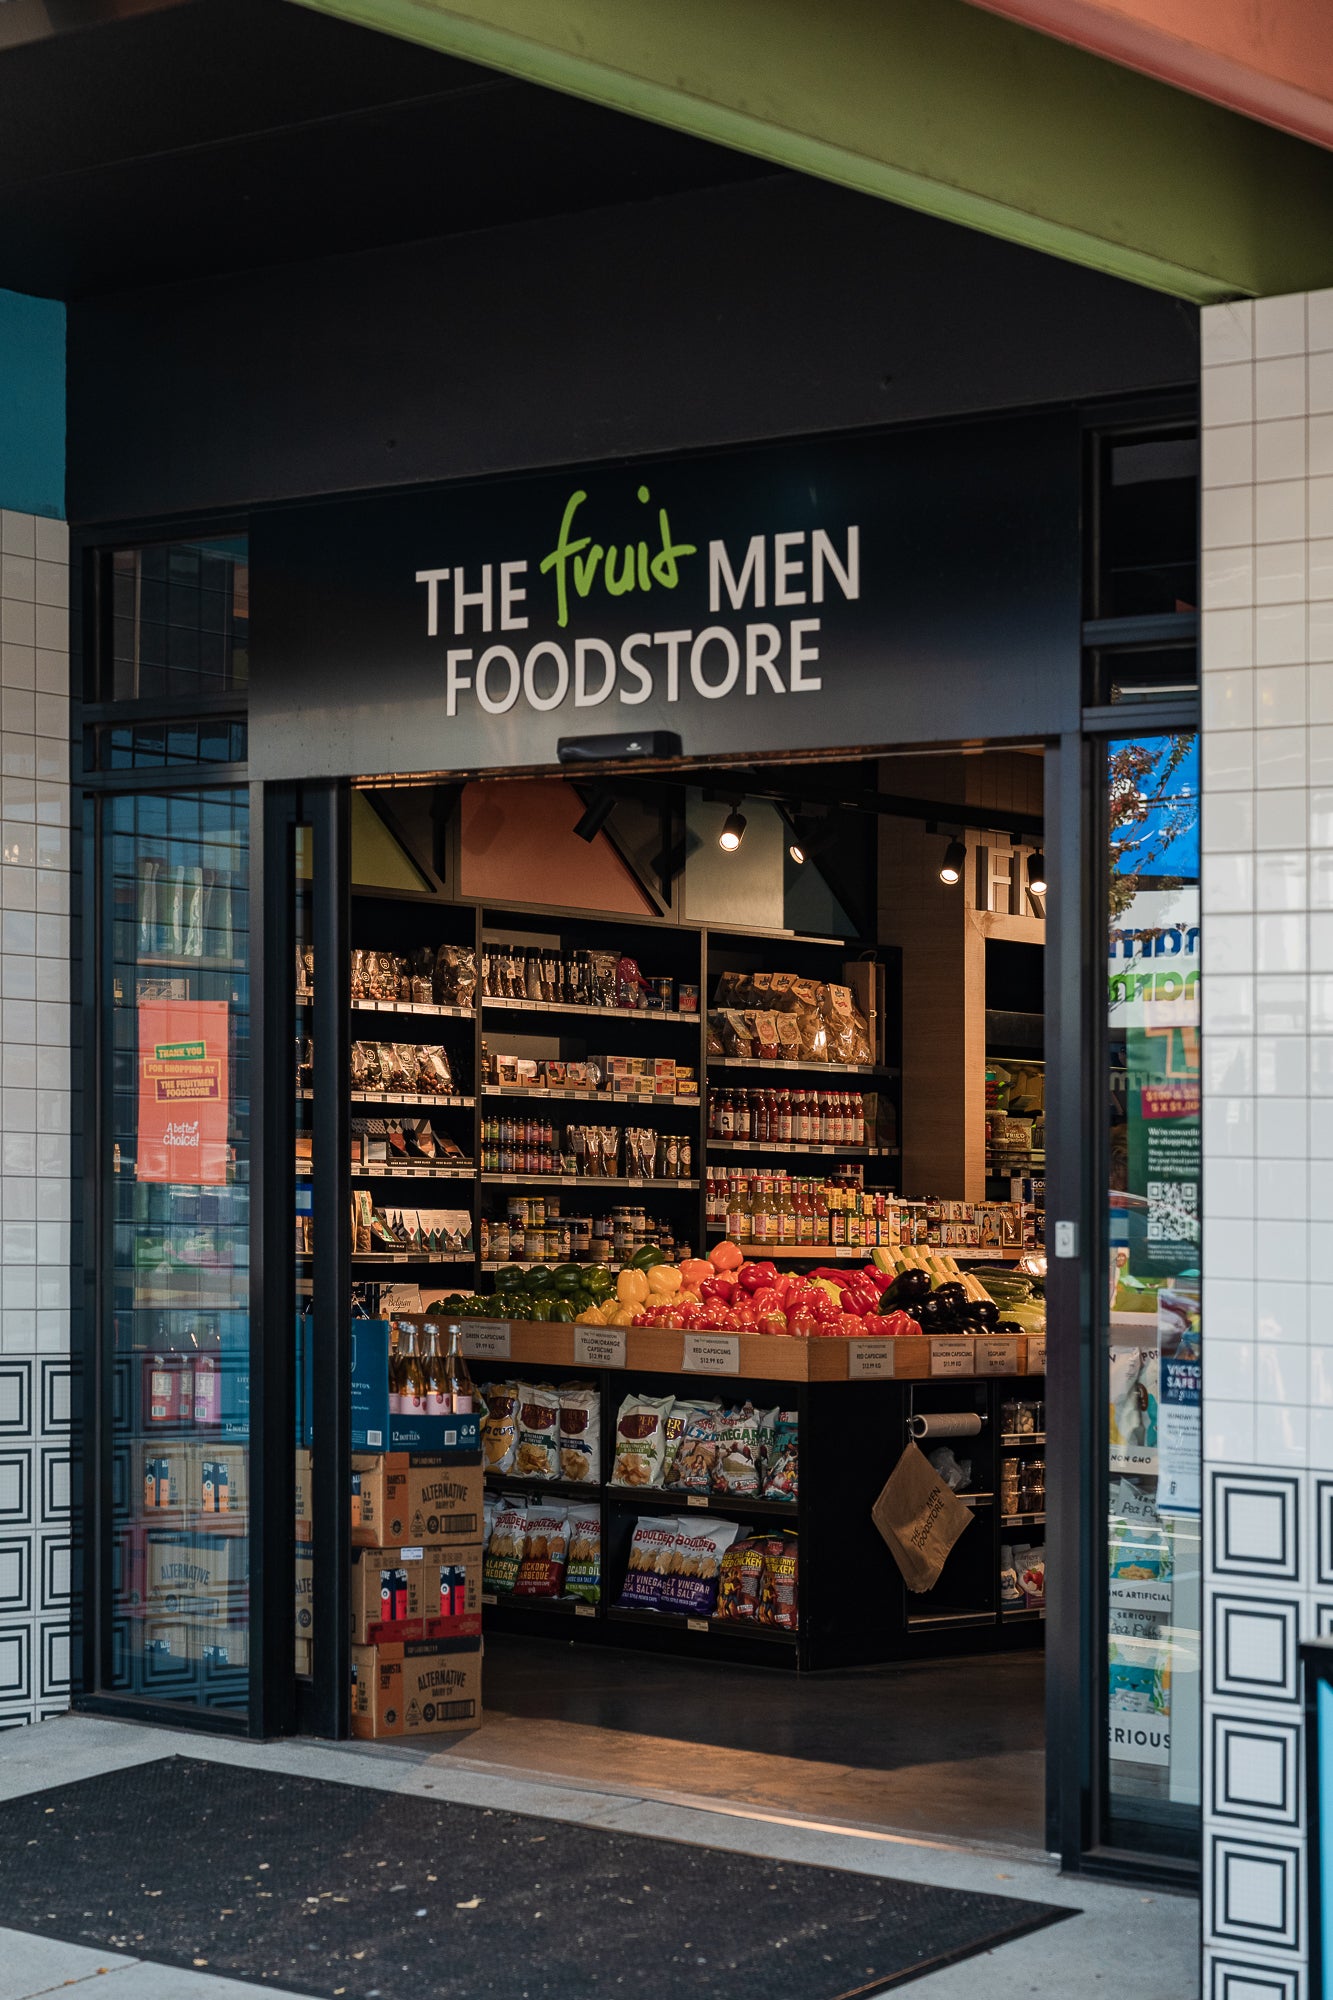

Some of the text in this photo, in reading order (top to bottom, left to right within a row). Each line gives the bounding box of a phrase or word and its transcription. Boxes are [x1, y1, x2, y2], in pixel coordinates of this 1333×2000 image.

[415, 485, 860, 636] THE fruit MEN
[446, 618, 823, 717] FOODSTORE
[158, 1046, 203, 1059] THANK YOU
[149, 1064, 215, 1074] FOR SHOPPING AT
[160, 1078, 214, 1089] THE FRUITMEN
[166, 1087, 210, 1098] FOODSTORE
[167, 1122, 196, 1133] A better
[163, 1132, 199, 1147] choice!
[480, 1333, 505, 1341] CAPSICUMS
[581, 1338, 620, 1347] YELLOW/ORANGE
[587, 1346, 613, 1354] CAPSICUMS
[692, 1347, 731, 1356] RED CAPSICUMS
[716, 1357, 724, 1365] KG
[392, 1431, 399, 1441] 12
[1110, 1453, 1152, 1464] NON GMO
[421, 1482, 469, 1504] ALTERNATIVE
[911, 1486, 941, 1546] THE MEN
[527, 1519, 563, 1532] BOULDER
[917, 1497, 945, 1551] FOODSTORE
[634, 1530, 675, 1548] BOULDER
[675, 1533, 717, 1553] BOULDER
[161, 1563, 210, 1586] ALTERNATIVE
[636, 1584, 655, 1596] SALT
[677, 1579, 711, 1595] VINEGAR
[677, 1588, 697, 1600] SALT
[1126, 1592, 1172, 1603] ARTIFICIAL
[1117, 1611, 1157, 1622] SERIOUS
[418, 1670, 467, 1692] ALTERNATIVE
